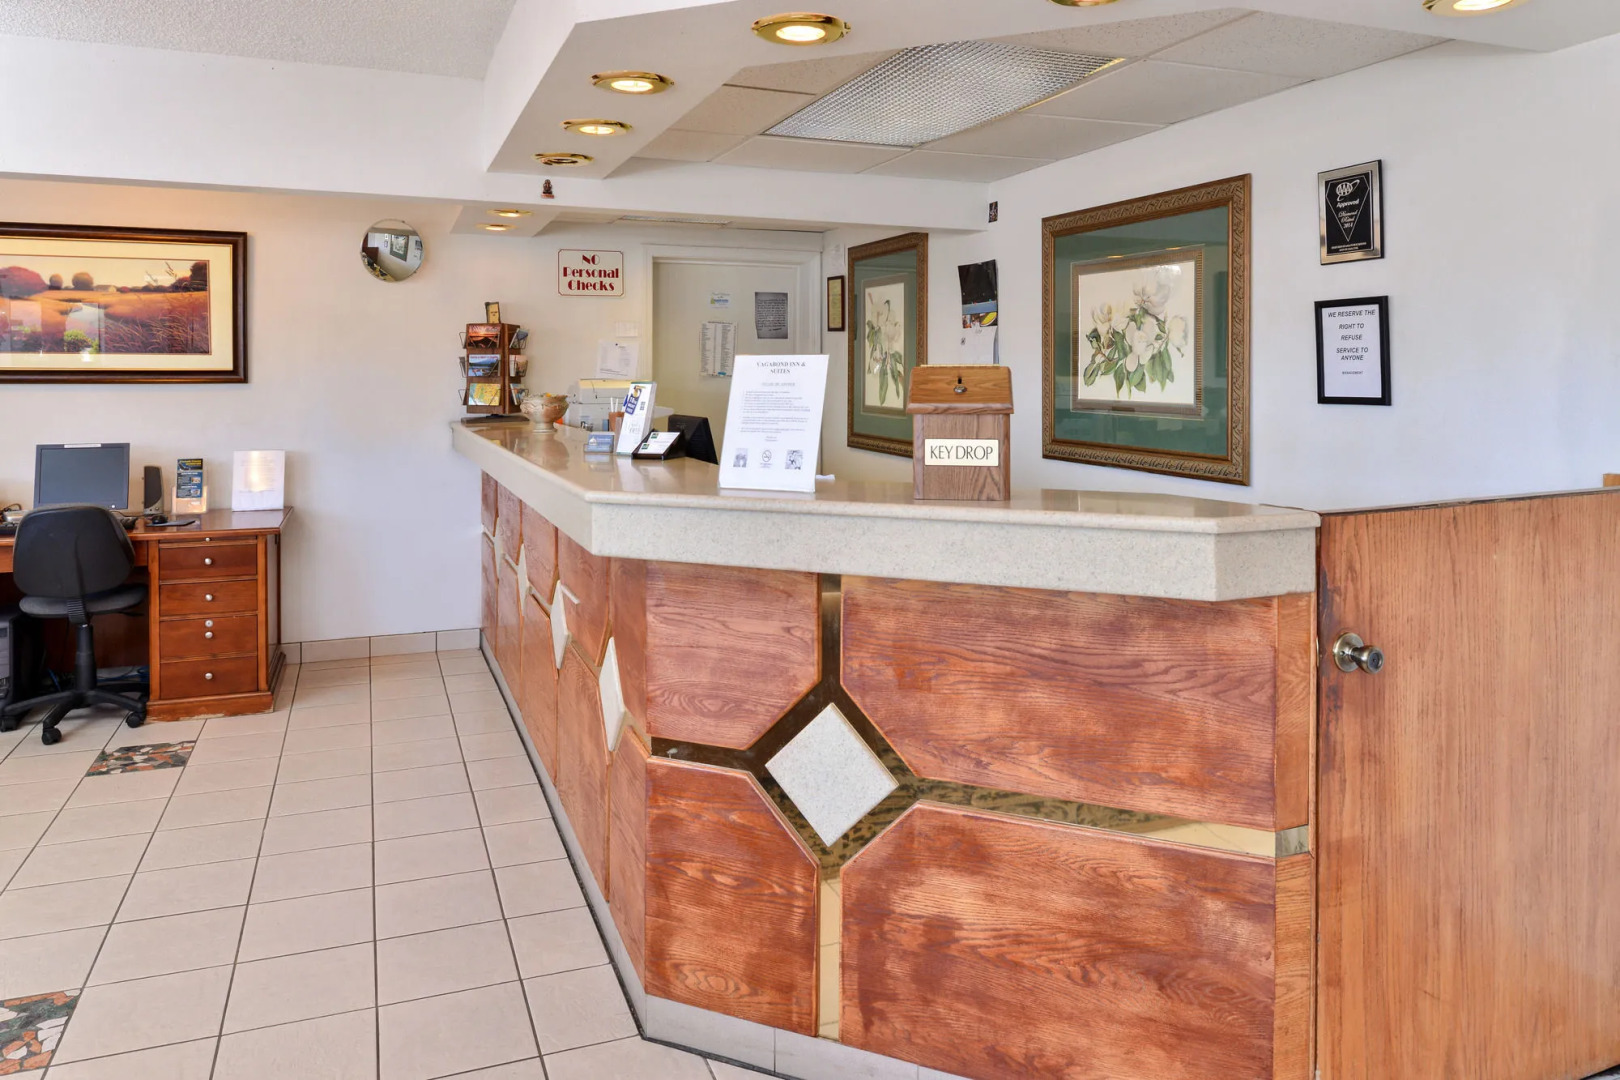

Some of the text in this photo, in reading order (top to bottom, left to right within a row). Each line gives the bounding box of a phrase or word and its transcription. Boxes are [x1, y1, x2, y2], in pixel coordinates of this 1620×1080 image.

[1336, 198, 1360, 208] Approved
[582, 254, 600, 265] NO
[563, 266, 619, 279] Personal
[568, 279, 615, 291] Checks
[930, 445, 993, 460] KEY DROP
